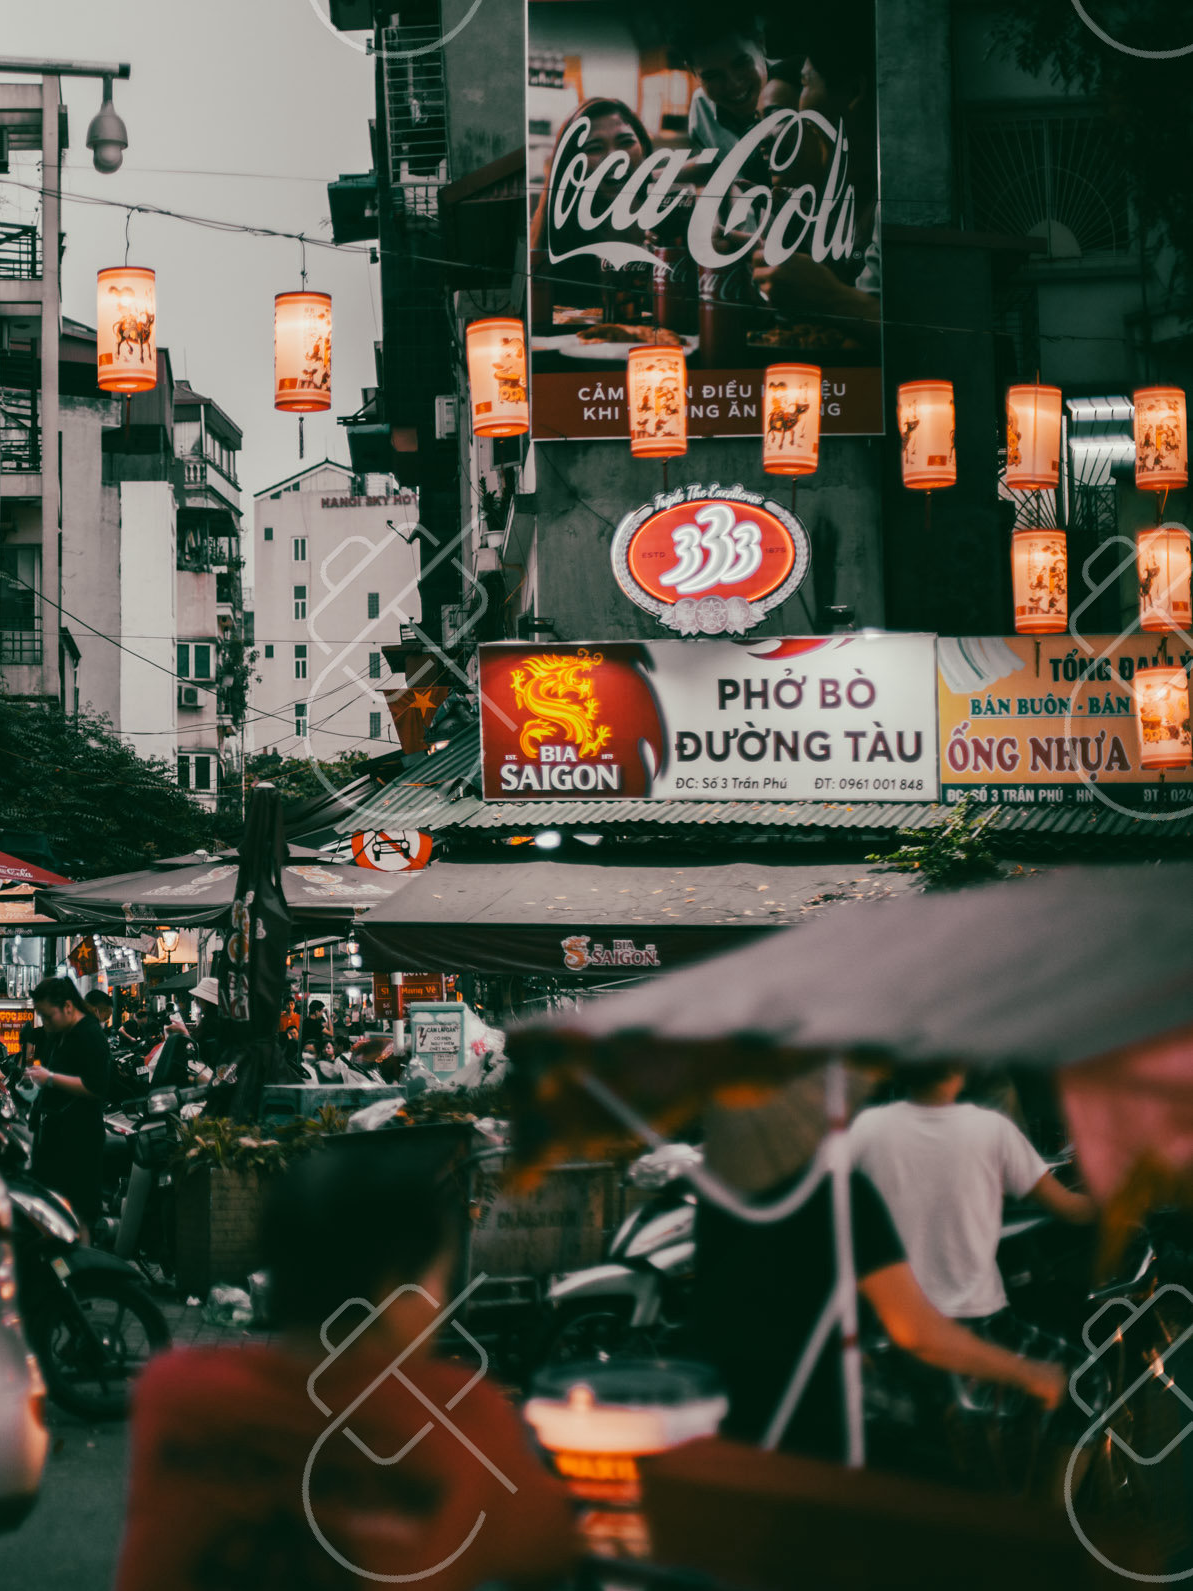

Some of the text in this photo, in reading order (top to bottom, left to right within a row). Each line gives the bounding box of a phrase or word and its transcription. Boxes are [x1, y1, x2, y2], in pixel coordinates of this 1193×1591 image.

[548, 108, 855, 272] Coca-Cola
[578, 382, 624, 401] CẢM
[702, 379, 752, 399] ĐIỀU
[583, 407, 619, 420] KHI
[727, 400, 757, 418] ĂN
[686, 484, 708, 500] The
[707, 484, 763, 505] Excellence
[659, 503, 762, 595] 333
[1049, 649, 1112, 683] TỔNG
[717, 668, 877, 711] PHỞ BÒ
[969, 694, 1011, 716] BÁN
[1016, 693, 1072, 716] BUÔN
[1087, 692, 1130, 715] BÁN
[675, 721, 923, 763] ĐƯỜNG TÀU
[947, 721, 1020, 773] ỐNG
[1028, 729, 1132, 782] NHỰA
[540, 746, 578, 762] BIA
[500, 764, 619, 791] SAIGON
[675, 775, 788, 789] ĐC: Số 3 Trần Phú
[814, 778, 924, 791] ĐT: 0961 001 848
[971, 785, 989, 802] SỐ
[991, 789, 999, 802] 3
[1001, 785, 1032, 802] TRẦN
[1038, 786, 1064, 802] PHÚ
[1076, 789, 1094, 802] HN
[613, 940, 636, 951] BIA
[591, 950, 657, 966] SAIGON
